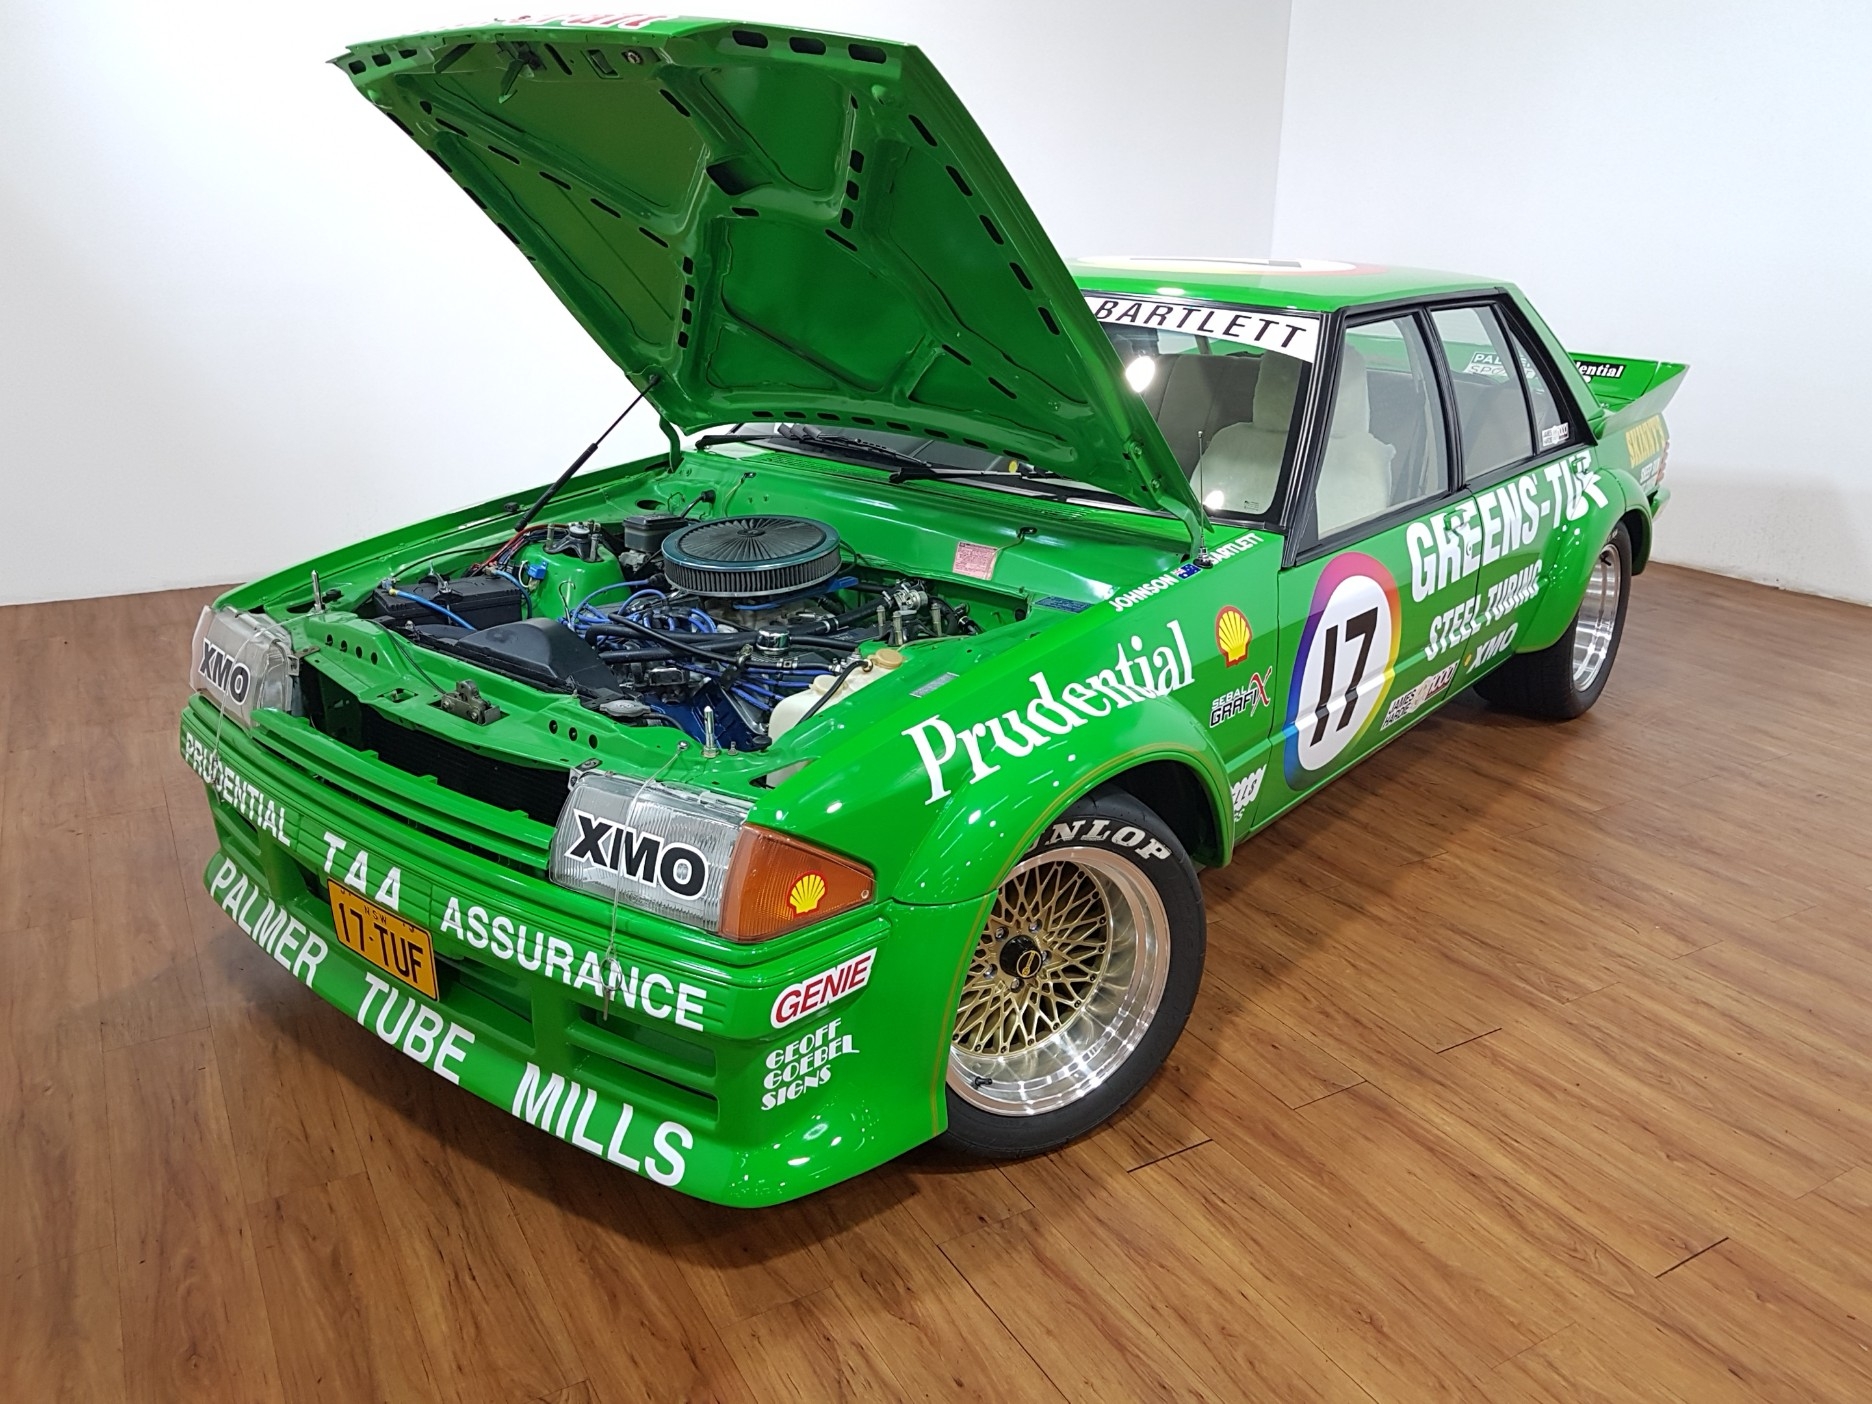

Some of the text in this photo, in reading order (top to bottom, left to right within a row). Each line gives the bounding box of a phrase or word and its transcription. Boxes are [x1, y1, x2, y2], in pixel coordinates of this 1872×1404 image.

[1094, 300, 1307, 348] BARTLETT
[1575, 361, 1624, 377] ential
[1109, 574, 1179, 612] JOHNSON
[1424, 559, 1543, 661] STEEL TUBING
[199, 639, 250, 704] XMO
[1310, 606, 1379, 747] 17
[1466, 622, 1518, 674] XMO
[901, 619, 1195, 805] Prudential
[1209, 666, 1272, 728] GRAFIX
[1212, 686, 1246, 710] SEBAL
[184, 732, 290, 847] PRUDENTIAL
[440, 897, 707, 1032] ASSURANCE
[567, 812, 707, 898] XMO
[364, 905, 387, 925] NSW
[774, 954, 872, 1024] GENIE
[210, 857, 694, 1187] PALMER TUBE MILLS
[766, 1018, 841, 1069] GEOFF
[761, 1065, 831, 1111] SIGNS
[764, 1035, 860, 1089] GOEBEL
